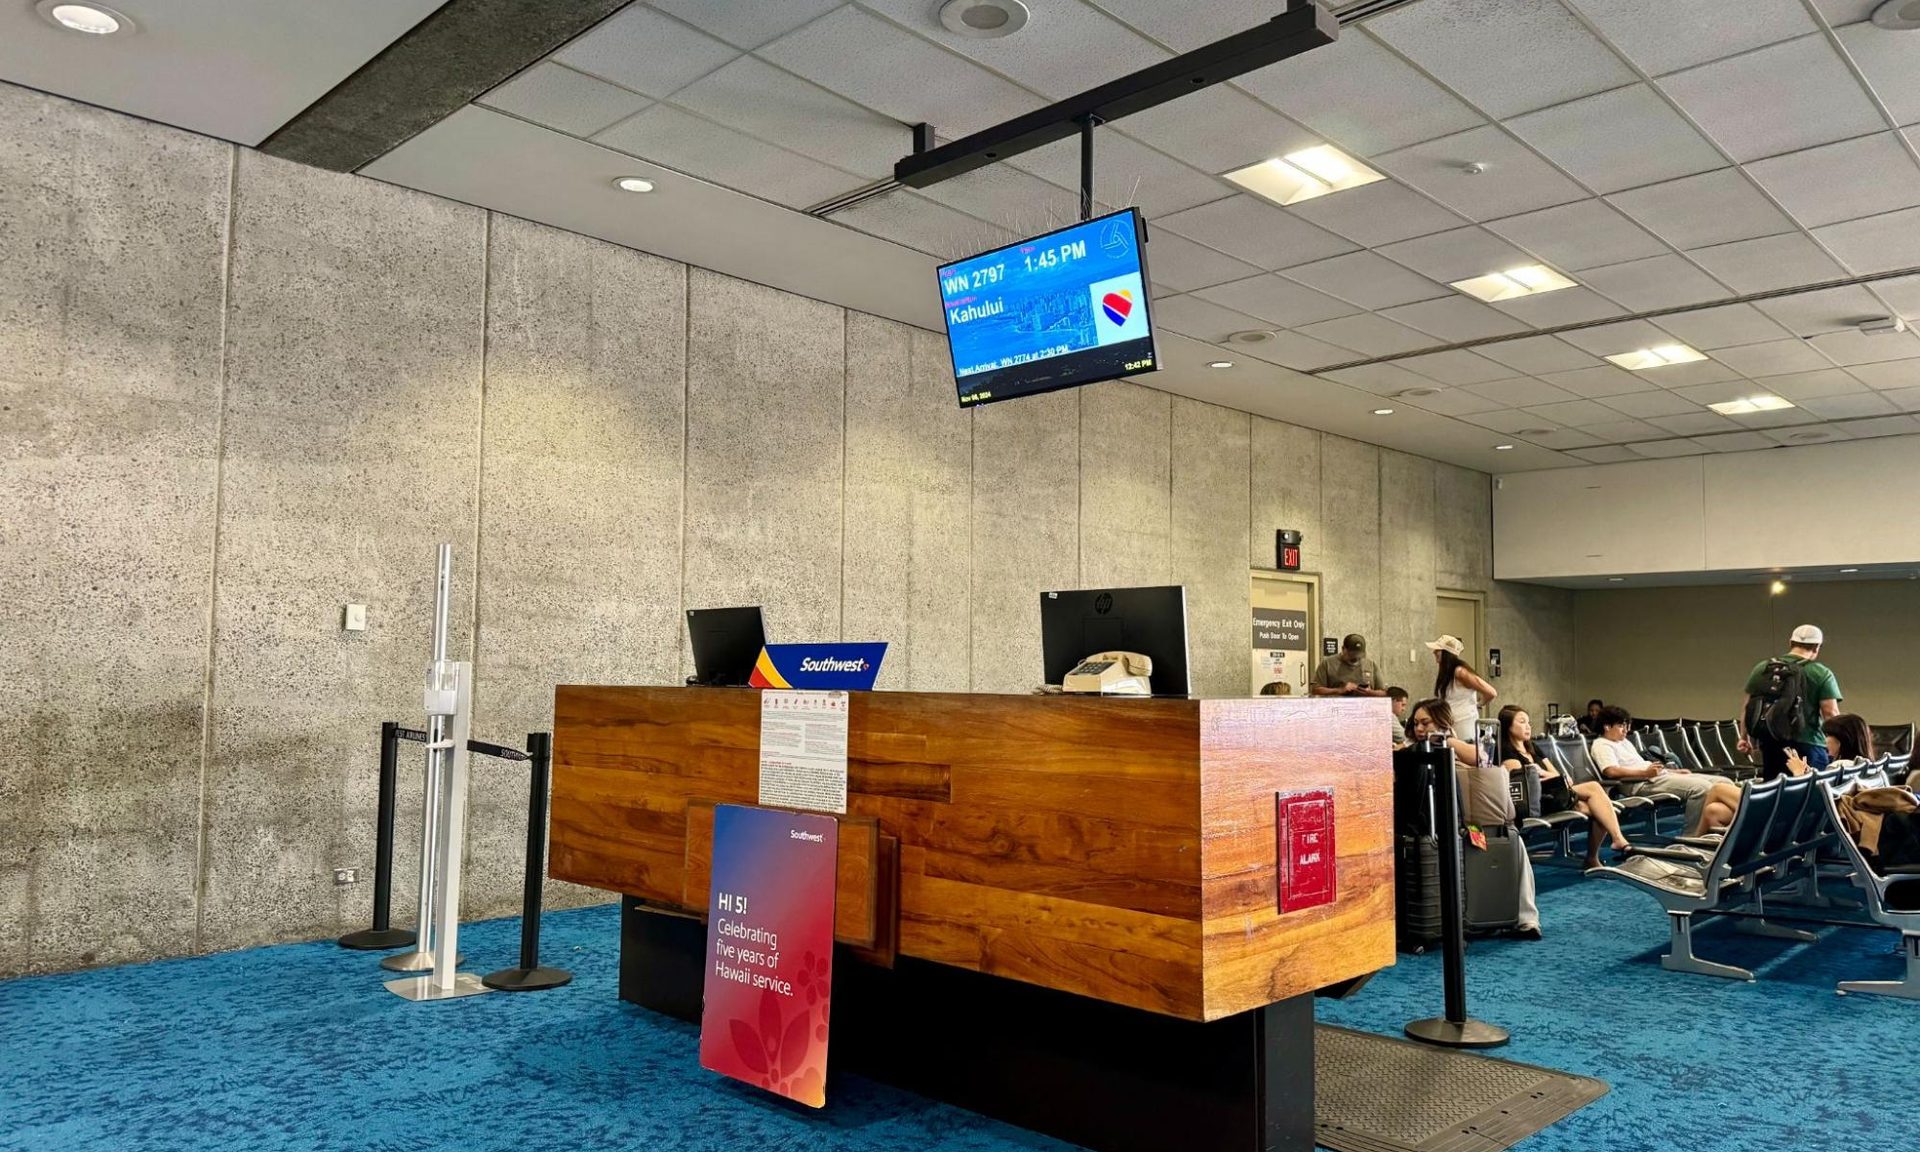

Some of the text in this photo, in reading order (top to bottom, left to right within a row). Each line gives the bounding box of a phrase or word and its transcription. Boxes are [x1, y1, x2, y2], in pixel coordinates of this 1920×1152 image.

[1024, 240, 1087, 272] 1:45 PM
[944, 274, 969, 295] WN
[972, 263, 1005, 288] 2797
[950, 296, 1004, 325] Kahului
[1056, 344, 1069, 355] PM
[1142, 359, 1152, 368] PM
[1284, 548, 1298, 567] EXIT
[1252, 617, 1305, 630] Emergency Exit Only
[1287, 632, 1300, 641] Open
[800, 656, 864, 672] Southwest
[790, 829, 823, 843] Southwest
[718, 892, 748, 915] HI 5!
[717, 918, 777, 951] Celebrating
[716, 938, 780, 969] five years of
[715, 960, 794, 996] Hawaii service.
